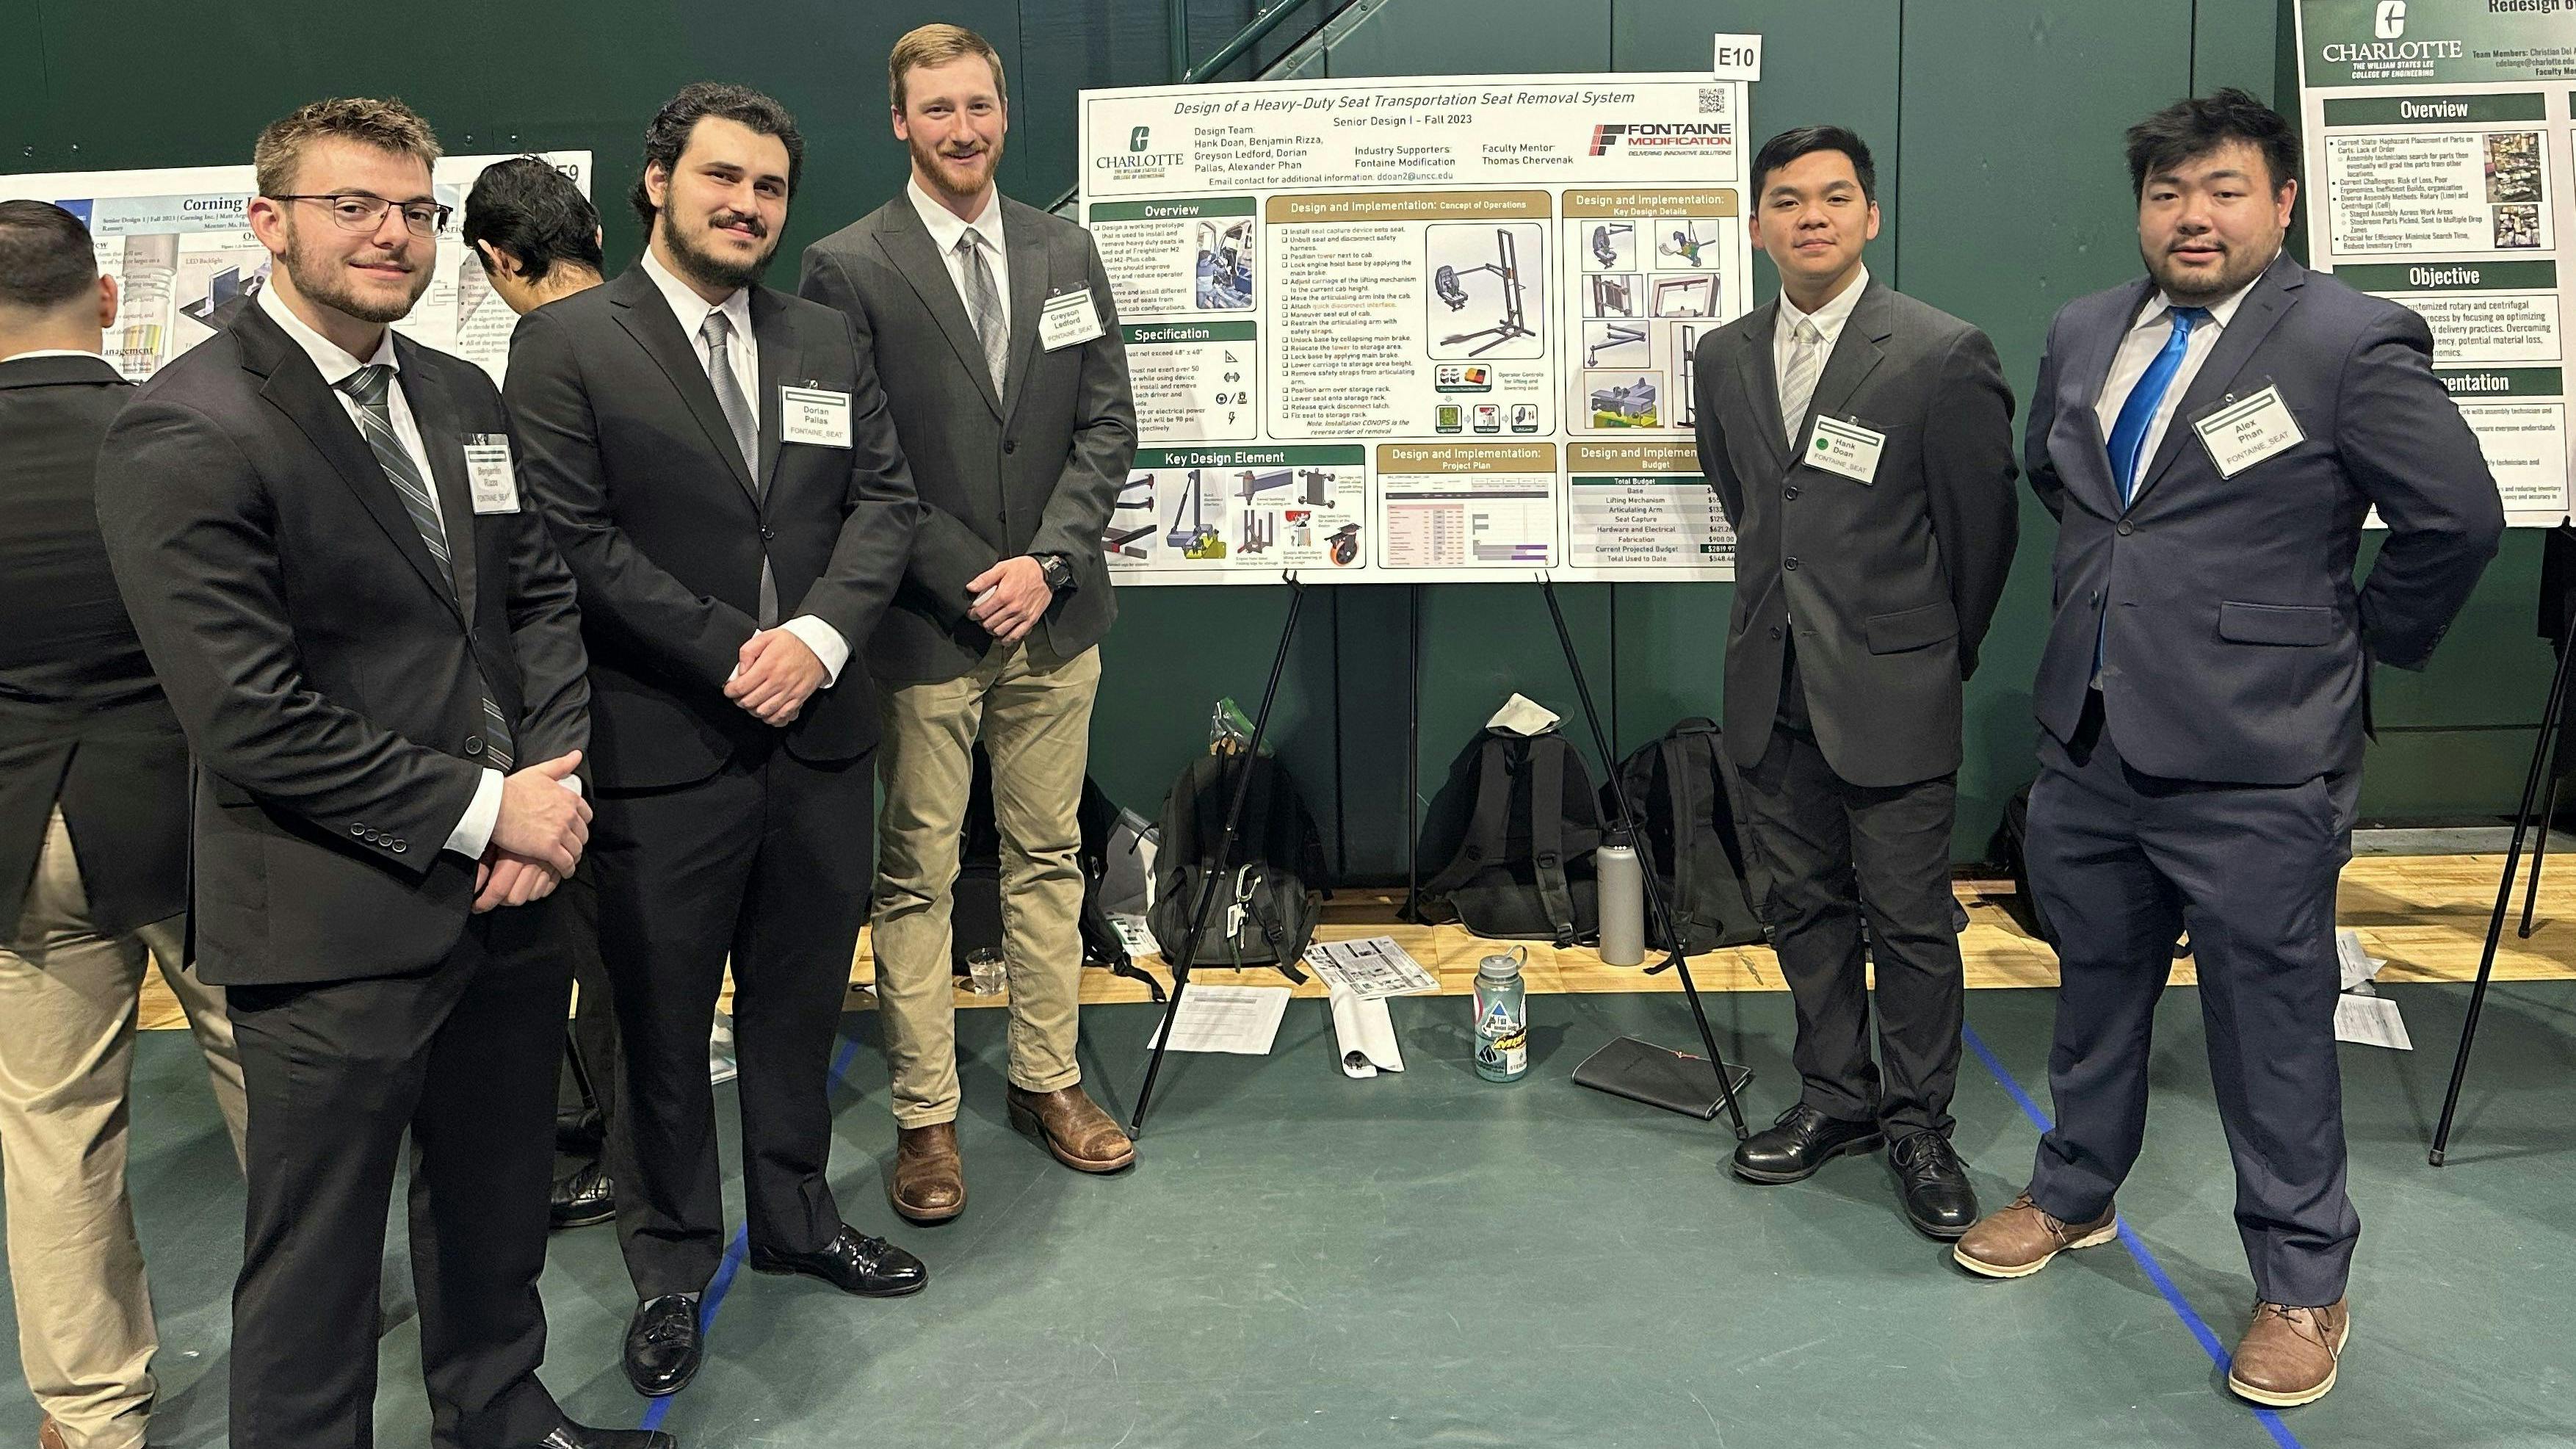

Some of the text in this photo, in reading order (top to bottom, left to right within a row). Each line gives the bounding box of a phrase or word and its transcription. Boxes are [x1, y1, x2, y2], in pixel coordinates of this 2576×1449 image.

[2489, 0, 2559, 13] Redesign
[2323, 40, 2462, 62] CHARLOTTE
[2530, 48, 2560, 56] Christian
[2561, 47, 2572, 55] Del
[1719, 48, 1754, 68] E10
[2352, 71, 2379, 79] COLLEGE
[2392, 70, 2434, 78] ENGINEERING
[1174, 91, 1635, 115] Design of a Heavy-Duty Seat Transportation Seat Removal System
[2400, 101, 2467, 119] Overview
[1334, 117, 1367, 127] Senior
[1370, 116, 1406, 127] Design
[1425, 115, 1444, 125] Fall
[1447, 115, 1472, 125] 2023
[1195, 127, 1226, 136] Design
[1628, 124, 1731, 134] FONTAINE
[1195, 135, 1323, 148] Hank Doan, Benjamin Rizza,
[1195, 148, 1307, 161] Greyson Ledford, Dorian
[1356, 145, 1394, 156] Industry
[1483, 144, 1513, 155] Faculty
[1097, 153, 1184, 169] CHARLOTTE
[1356, 156, 1455, 167] Fontaine Modification
[1483, 156, 1574, 165] Thomas Chervenak
[1195, 160, 1301, 174] Pallas, Alexander Phan
[1209, 177, 1233, 186] Email
[1234, 176, 1265, 185] contact
[1267, 176, 1279, 184] for
[1281, 175, 1322, 183] additional
[1377, 173, 1453, 181] ddoan2@uncc.edu
[184, 199, 242, 212] Corning
[1577, 195, 1723, 206] Design and Implementation:
[1146, 205, 1199, 217] Overview
[1291, 203, 1326, 214] Design
[1330, 202, 1349, 212] and
[1352, 200, 1436, 212] Implementation:
[1440, 201, 1472, 211] Concept
[1483, 200, 1526, 210] Operations
[1630, 208, 1657, 217] Design
[2409, 267, 2480, 286] Objective
[2450, 300, 2529, 311] rotary and centrifugal
[1051, 310, 1079, 320] Greyson
[2453, 313, 2461, 323] by
[2463, 312, 2493, 322] focusing
[2506, 312, 2545, 322] optimizing
[1054, 317, 1080, 328] Ledford
[2438, 323, 2550, 333] delivery practices. Overcoming
[1135, 328, 1209, 342] Specification
[2436, 335, 2542, 346] iency, potential material loss,
[104, 347, 153, 356] anagement
[2440, 375, 2508, 391] entation
[804, 406, 828, 415] Dorian
[806, 416, 828, 424] Pallas
[2236, 419, 2256, 433] Alex
[791, 427, 843, 438] FONTAINE_SEAT
[2238, 430, 2262, 444] Phan
[1836, 438, 1856, 449] Hank
[2227, 431, 2288, 464] FONTAINE_SEAT
[1392, 449, 1540, 460] Design and Implementation:
[1582, 447, 1696, 459] Design and Implemen
[1834, 447, 1853, 458] Doan
[1165, 452, 1284, 466] Key Design Element
[1442, 462, 1470, 470] Project
[1643, 461, 1669, 469] Budget
